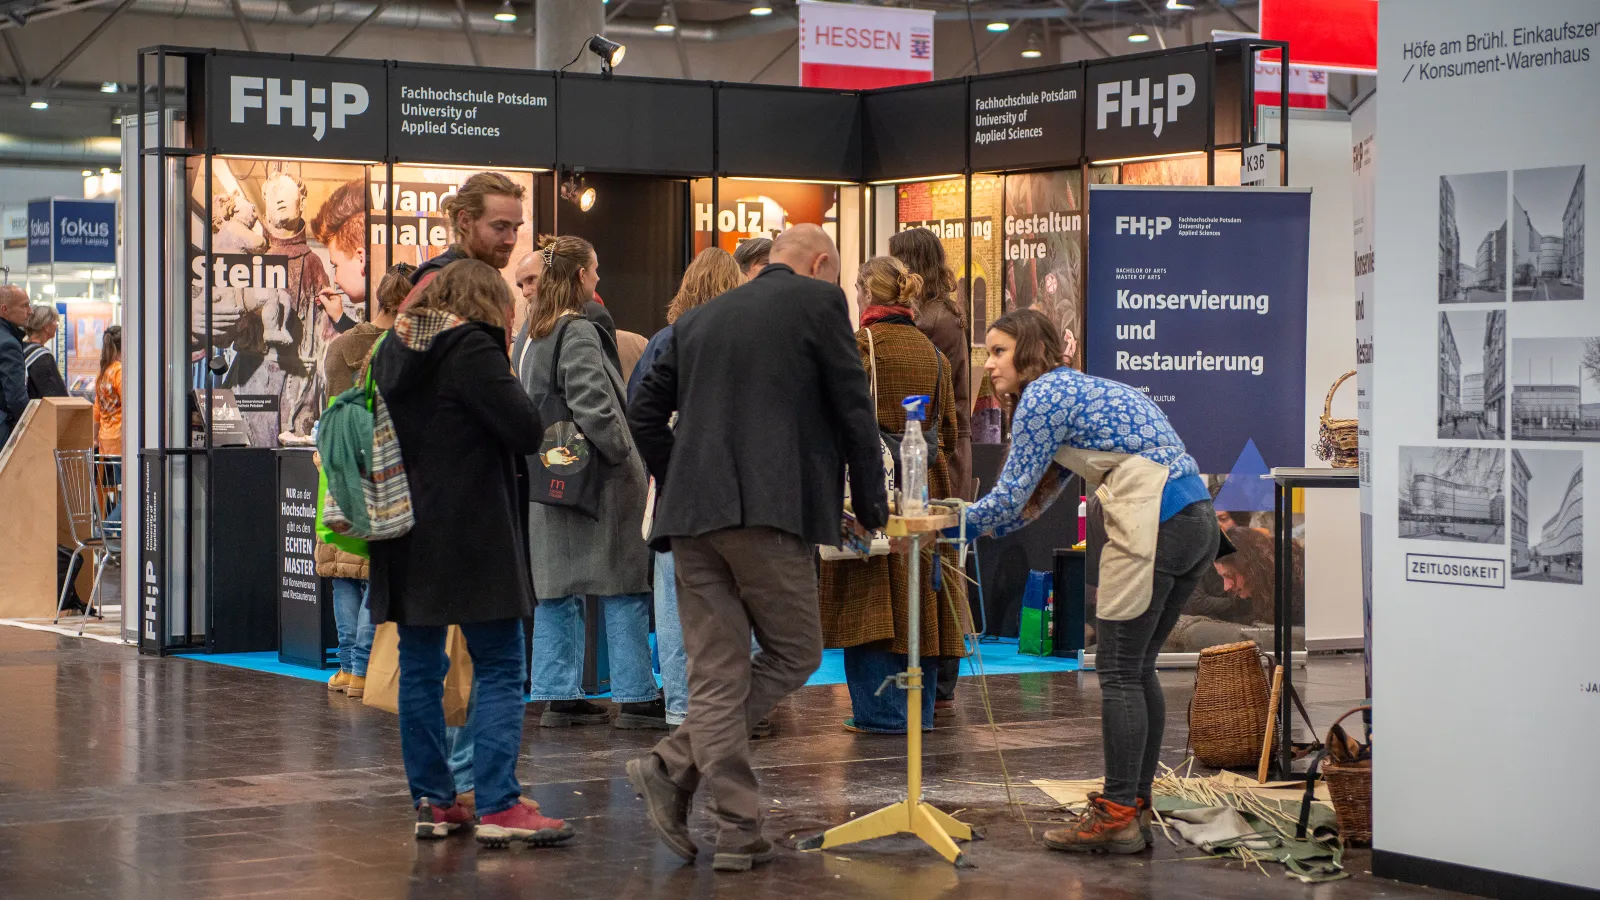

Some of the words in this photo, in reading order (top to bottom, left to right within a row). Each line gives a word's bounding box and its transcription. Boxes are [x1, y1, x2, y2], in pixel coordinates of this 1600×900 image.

[815, 25, 901, 51] HESSEN
[1403, 40, 1435, 60] Höfe
[1440, 40, 1461, 56] am
[1466, 30, 1508, 52] Brühl.
[1419, 47, 1590, 81] Konsument-Warenhaus
[401, 86, 494, 104] Fachhochschule
[497, 92, 549, 107] Potsdam
[975, 92, 1039, 111] Fachhochschule
[1041, 88, 1077, 104] Potsdam
[1096, 73, 1196, 139] FH;P
[230, 75, 370, 142] FH;P
[401, 103, 462, 121] University
[464, 106, 478, 119] of
[975, 111, 1018, 127] University
[1018, 109, 1028, 123] of
[401, 119, 447, 136] Applied
[450, 122, 501, 137] Sciences
[975, 129, 1006, 145] Applied
[1008, 126, 1043, 140] Sciences
[1246, 153, 1265, 173] K36
[30, 218, 50, 238] fokus
[61, 216, 109, 237] fokus
[694, 202, 762, 233] Holz
[1115, 215, 1172, 241] FH;P
[61, 236, 82, 245] GmbH
[1004, 238, 1047, 261] lehre
[190, 255, 287, 289] Stein
[1116, 289, 1269, 315] Konservierung
[1116, 319, 1156, 340] und
[1116, 350, 1264, 376] Restaurierung
[285, 488, 297, 499] NUR
[297, 490, 303, 499] an
[303, 489, 312, 500] der
[281, 502, 316, 518] Hochschule
[286, 521, 296, 534] gibt
[296, 524, 302, 533] es
[302, 522, 311, 533] den
[285, 536, 313, 554] ECHTEN
[284, 557, 314, 576] MASTER
[1411, 561, 1499, 579] ZEITLOSIGKEIT
[289, 577, 316, 591] Konservierung
[145, 560, 159, 640] FH;P
[282, 589, 290, 598] und
[290, 589, 317, 604] Restaurierung
